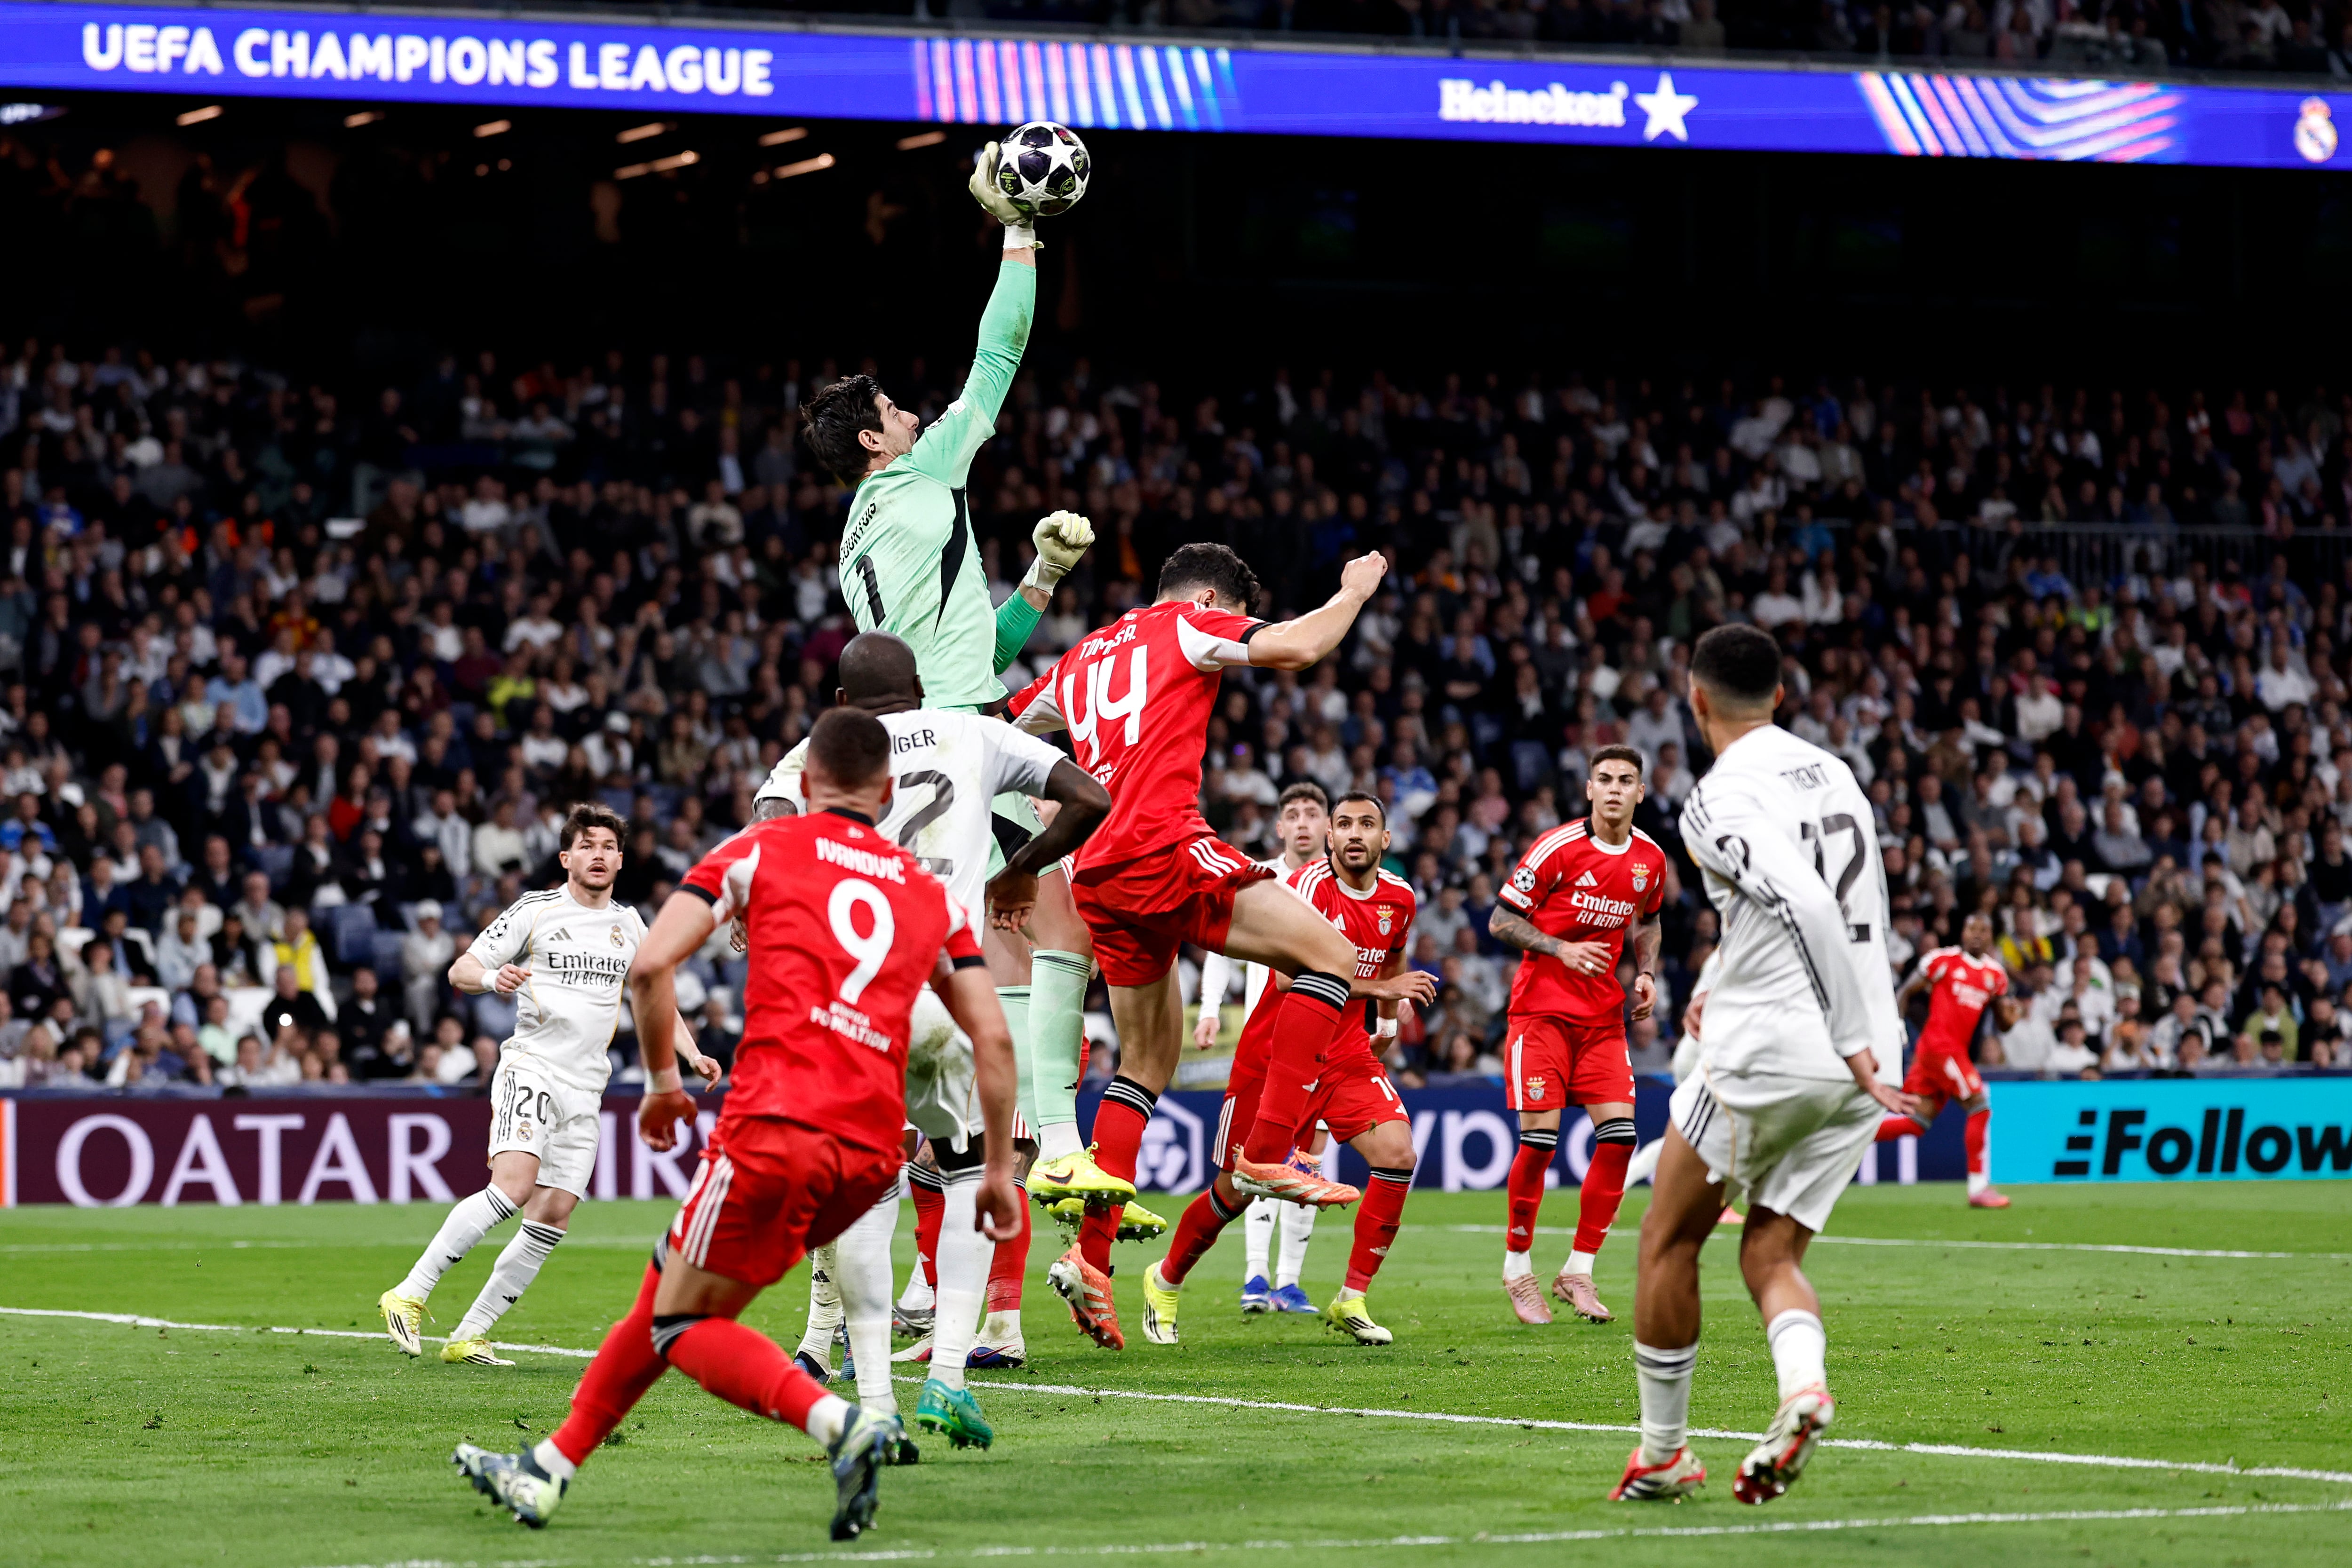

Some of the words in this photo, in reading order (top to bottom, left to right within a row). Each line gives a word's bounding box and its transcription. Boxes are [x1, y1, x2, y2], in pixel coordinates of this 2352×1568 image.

[82, 22, 224, 75] UEFA
[233, 27, 559, 88] CHAMPIONS
[568, 41, 774, 96] LEAGUE
[1438, 78, 1629, 127] Heineken
[856, 554, 886, 628] 1
[1063, 644, 1148, 768] 44
[898, 769, 954, 876] 2
[1570, 890, 1636, 916] Emirates
[1576, 910, 1596, 925] FLY
[548, 951, 627, 974] Emirates
[827, 878, 895, 1005] 9
[1353, 945, 1387, 963] rates
[561, 971, 580, 985] FLY
[582, 971, 616, 988] BETTER
[1354, 962, 1376, 977] TTER
[516, 1086, 551, 1125] 20
[2102, 1108, 2352, 1175] Follow
